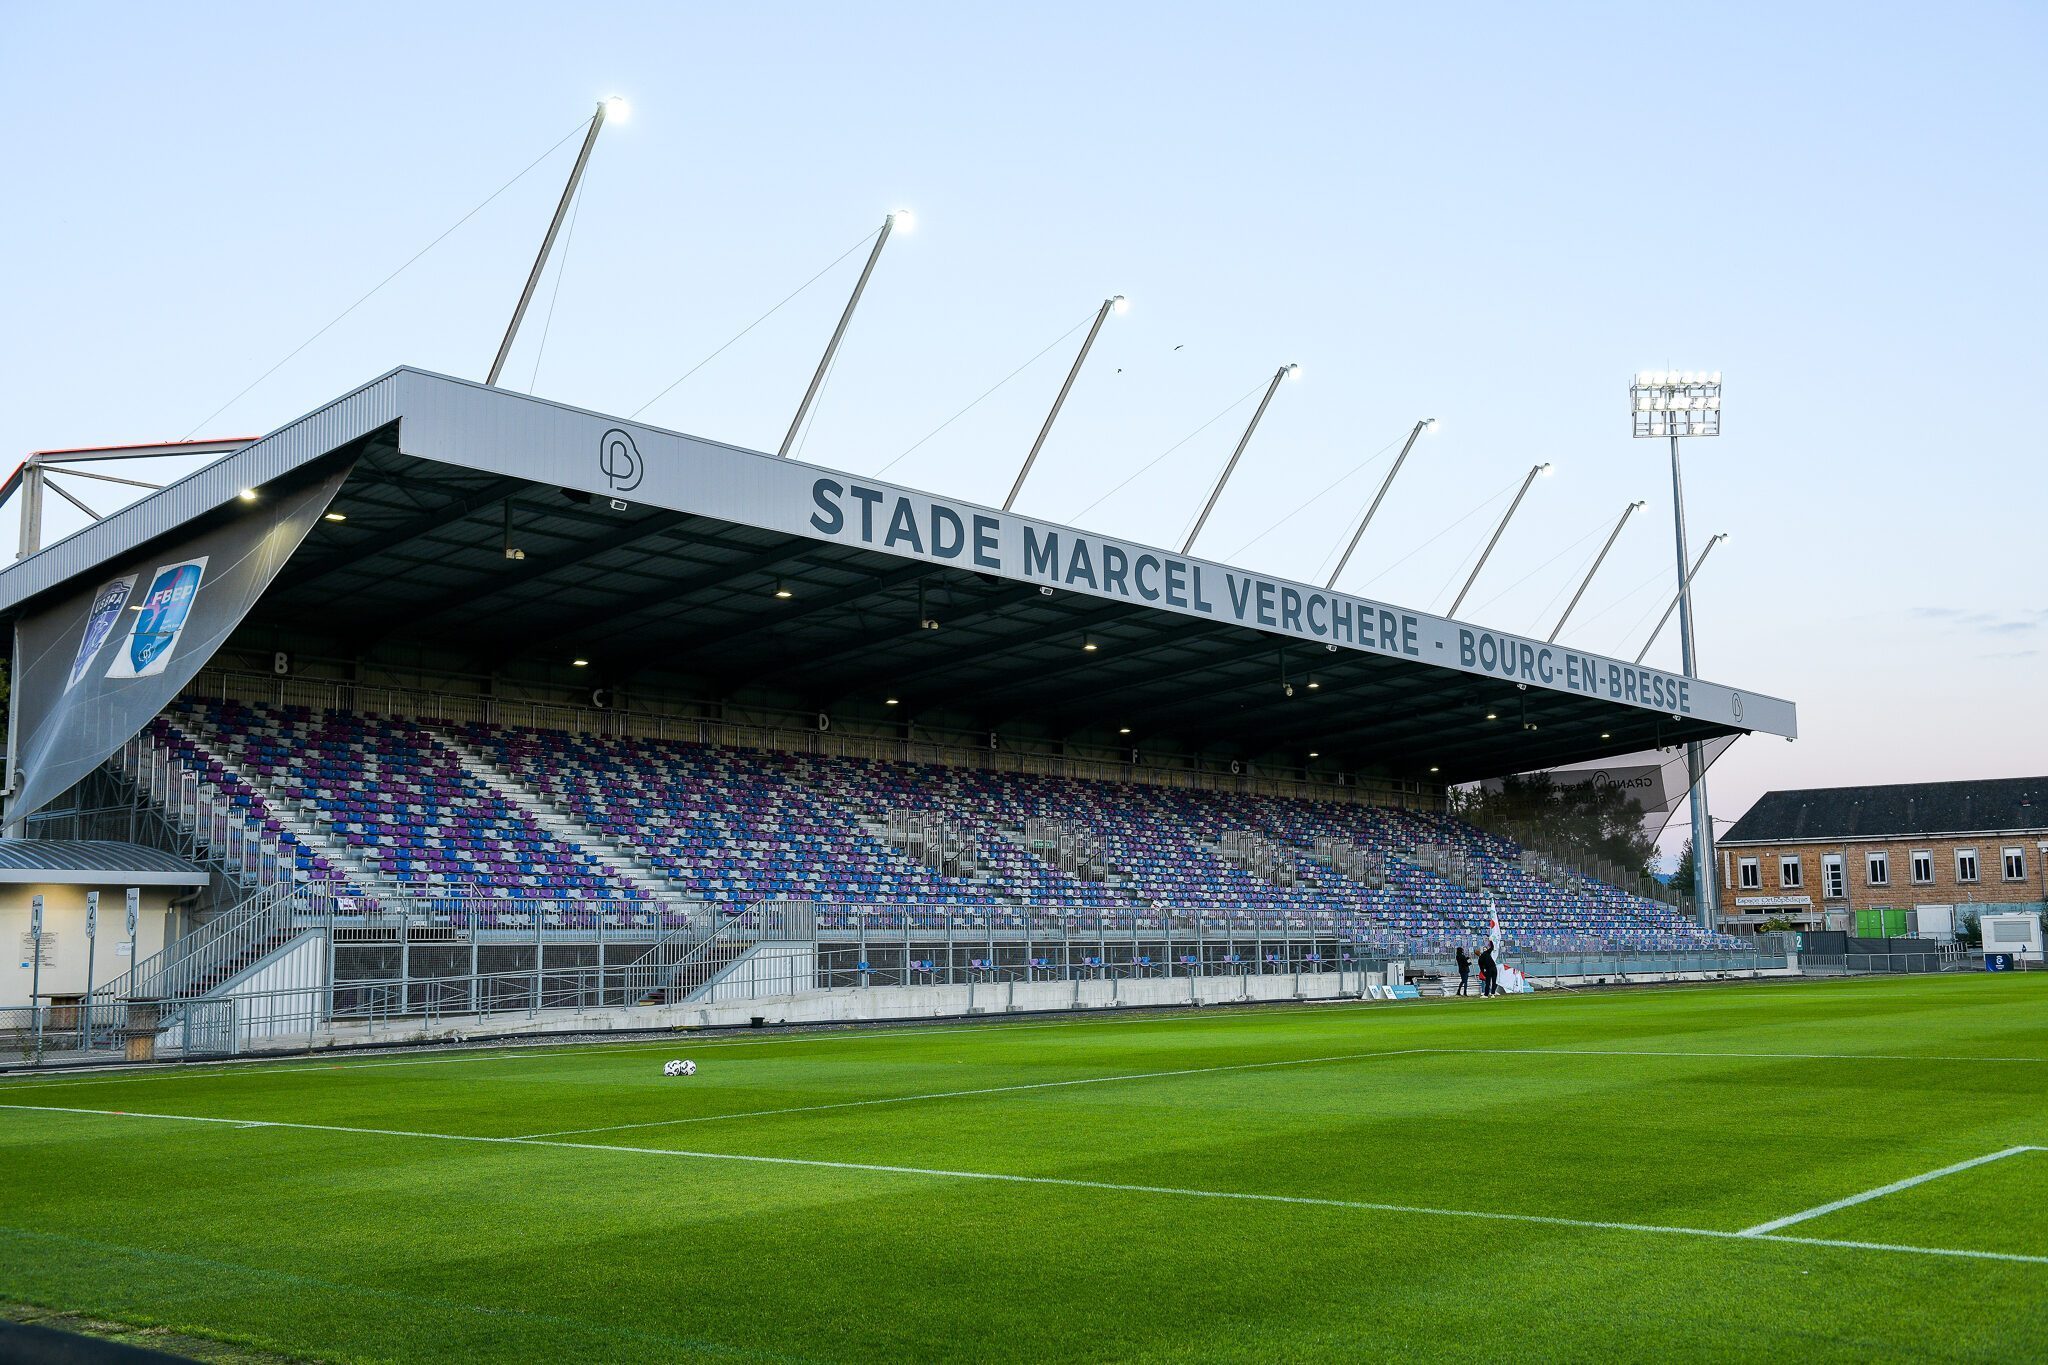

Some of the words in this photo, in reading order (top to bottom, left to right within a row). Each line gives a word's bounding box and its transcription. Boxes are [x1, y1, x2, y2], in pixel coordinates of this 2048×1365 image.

[810, 478, 1000, 569] STADE
[1023, 526, 1212, 613] MARCEL
[1226, 574, 1419, 656] VERCHERE
[1459, 628, 1691, 713] BOURG-EN-BRESSE
[275, 652, 288, 675] B
[593, 689, 603, 708] C
[819, 713, 830, 731] D
[991, 732, 997, 749] E
[1133, 749, 1139, 764] F
[1231, 760, 1240, 774] G
[1338, 772, 1345, 786] H
[89, 906, 94, 920] 2
[1796, 935, 1802, 948] 2
